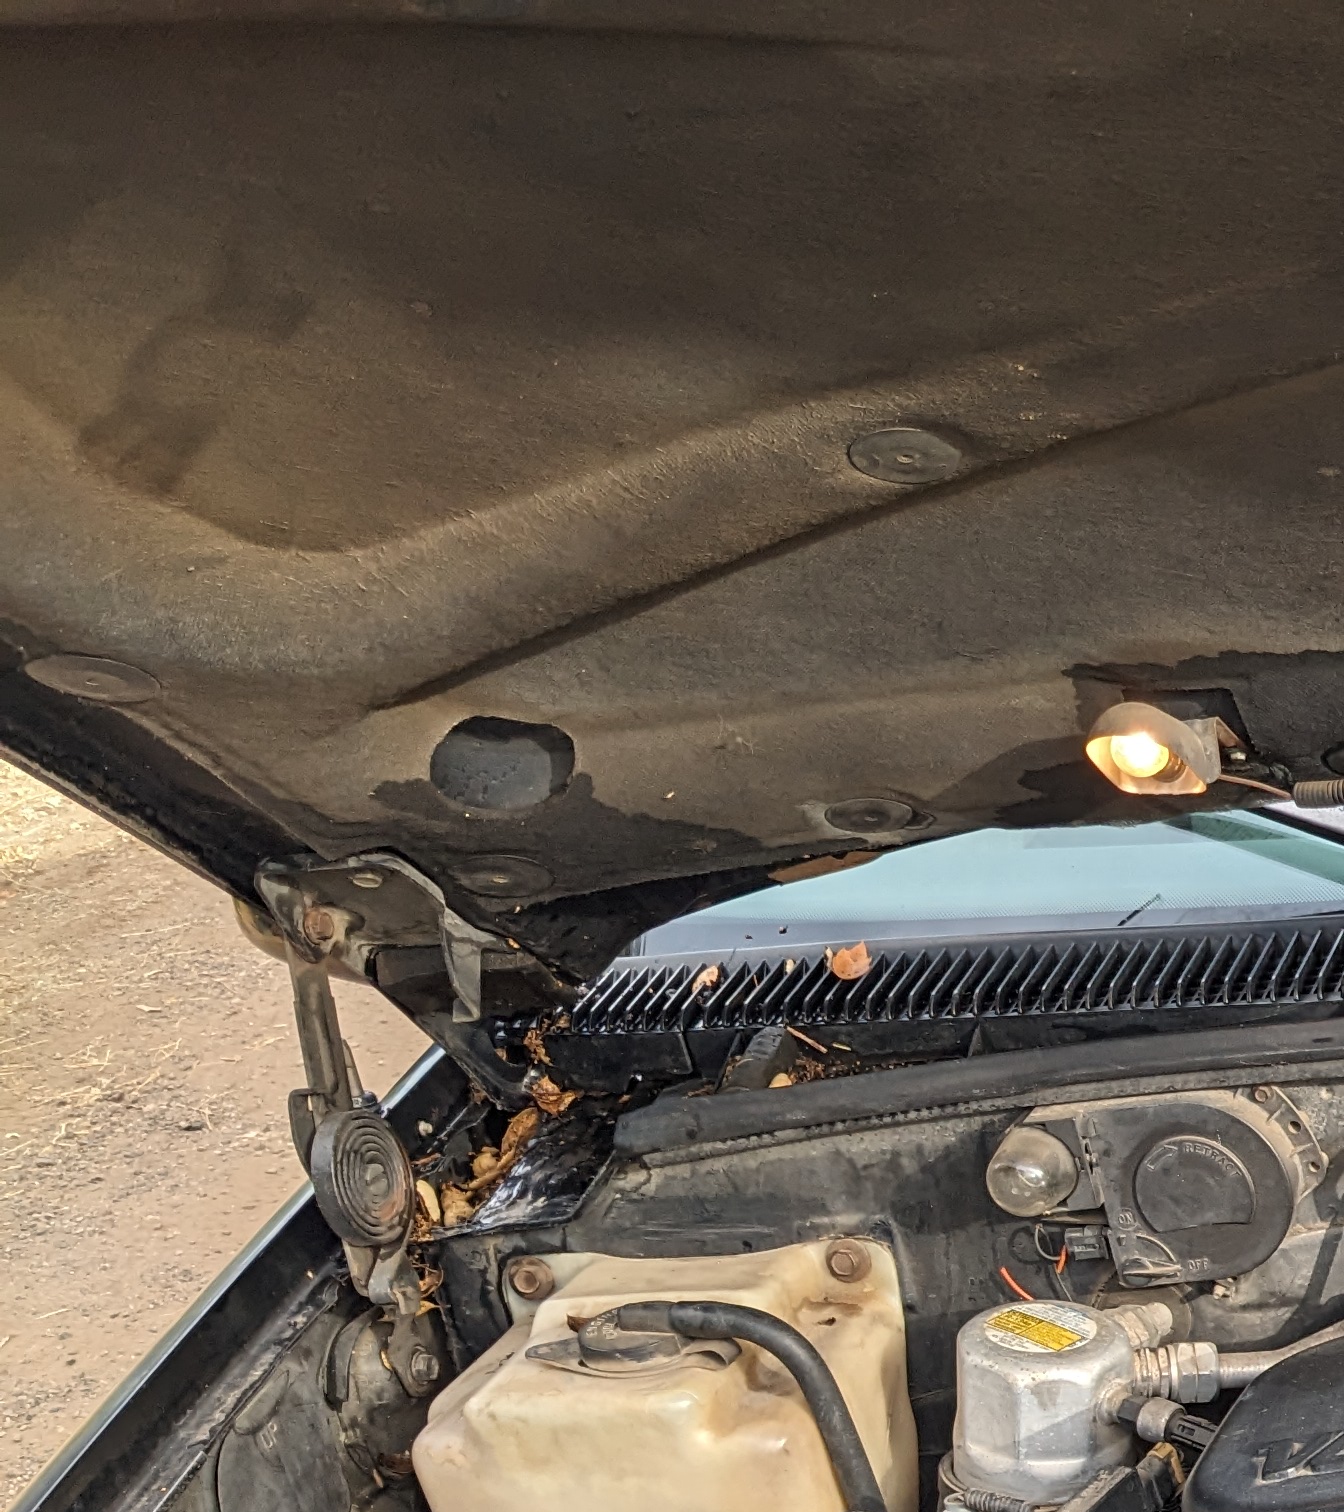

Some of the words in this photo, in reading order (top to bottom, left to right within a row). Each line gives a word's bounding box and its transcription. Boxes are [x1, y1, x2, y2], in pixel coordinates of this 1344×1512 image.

[1181, 1142, 1242, 1177] RETRACT
[1118, 1211, 1133, 1225] ON
[1187, 1258, 1210, 1271] OFF
